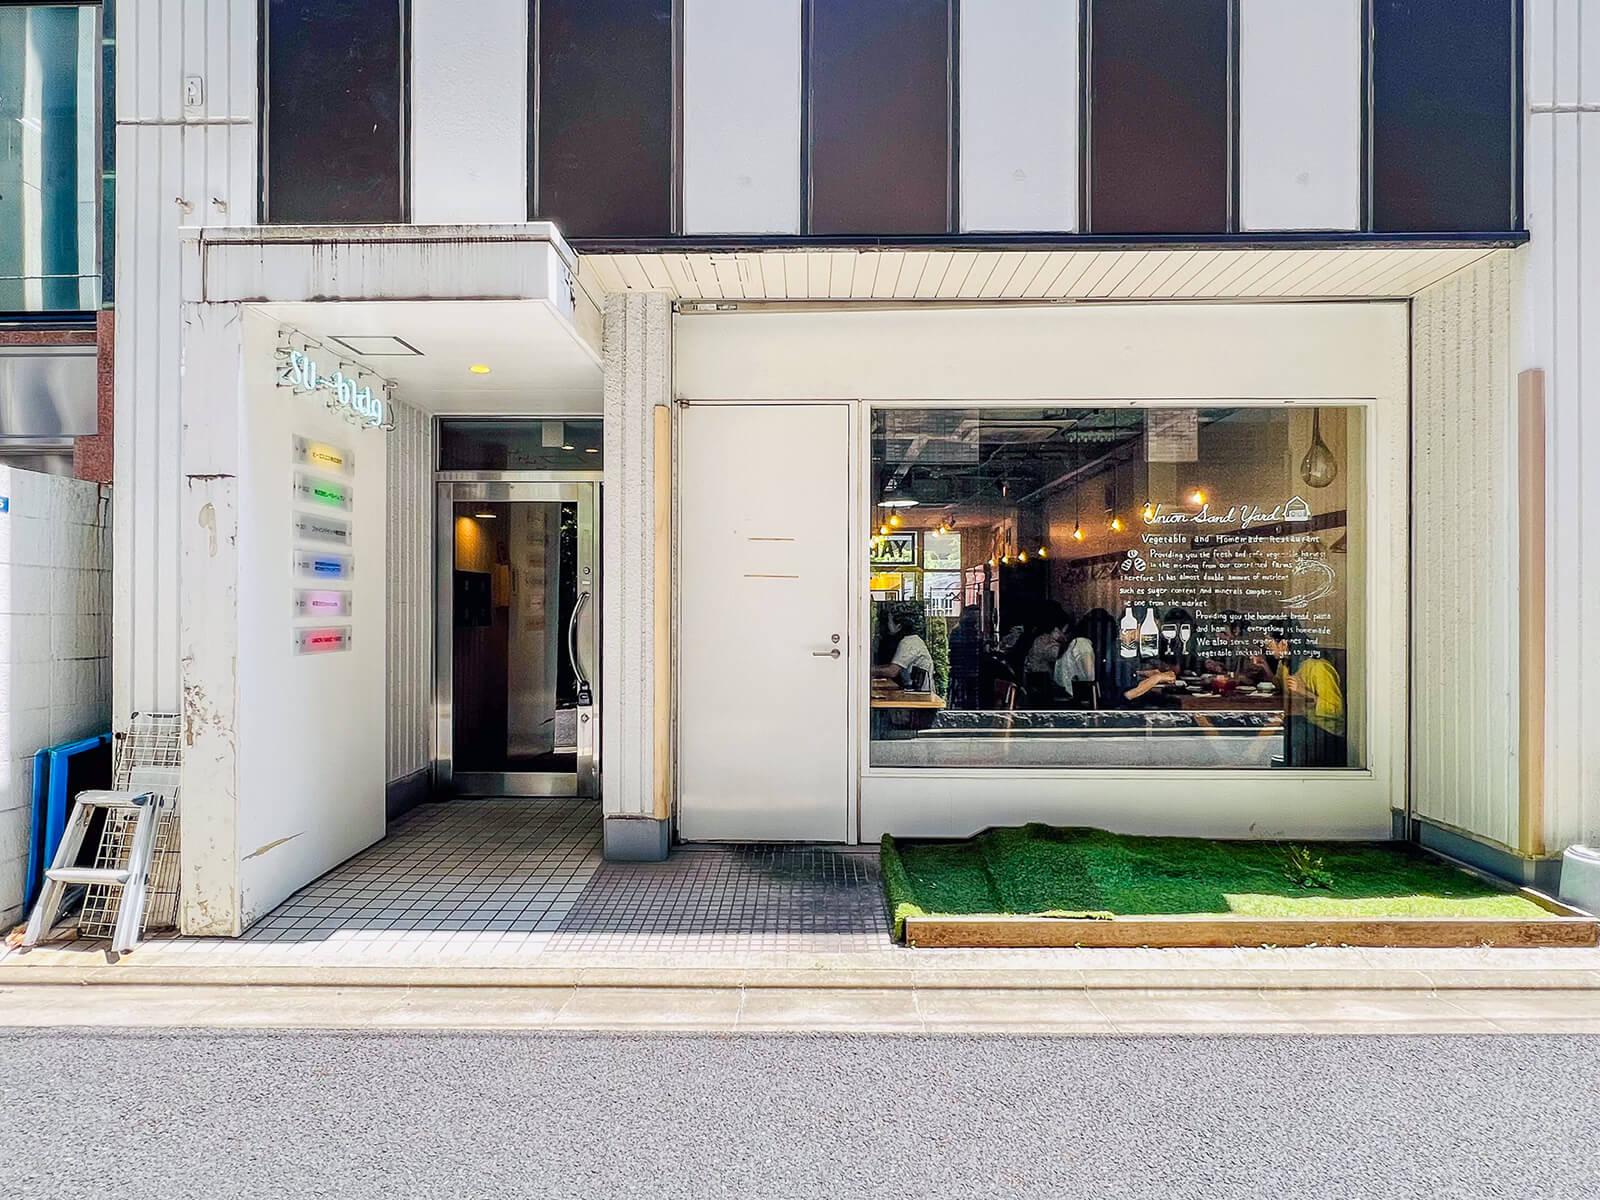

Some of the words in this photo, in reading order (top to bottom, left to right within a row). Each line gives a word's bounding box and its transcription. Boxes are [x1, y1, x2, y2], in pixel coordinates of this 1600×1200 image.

[1143, 502, 1188, 525] Union
[1190, 504, 1236, 523] Sand
[1240, 505, 1282, 528] Yard
[1141, 534, 1187, 545] Vegetable
[1194, 534, 1209, 543] and
[1216, 534, 1264, 543] Homemade
[1269, 535, 1320, 544] Restaurant
[1150, 549, 1183, 560] Providing
[1184, 552, 1198, 561] you
[1199, 550, 1211, 559] the
[1212, 549, 1233, 559] fresh
[1235, 550, 1246, 558] and
[1266, 550, 1298, 561] vegeble
[1158, 561, 1170, 569] the
[1202, 561, 1217, 569] from
[1179, 573, 1200, 581] almost
[1195, 610, 1227, 622] Providing
[1229, 614, 1242, 623] you
[1244, 611, 1256, 620] the
[1196, 625, 1208, 633] and
[1247, 625, 1285, 636] everything
[1287, 626, 1294, 634] is
[1197, 637, 1211, 646] We
[1212, 637, 1228, 646] also
[1252, 638, 1276, 648] orga
[1197, 648, 1233, 658] vegetable
